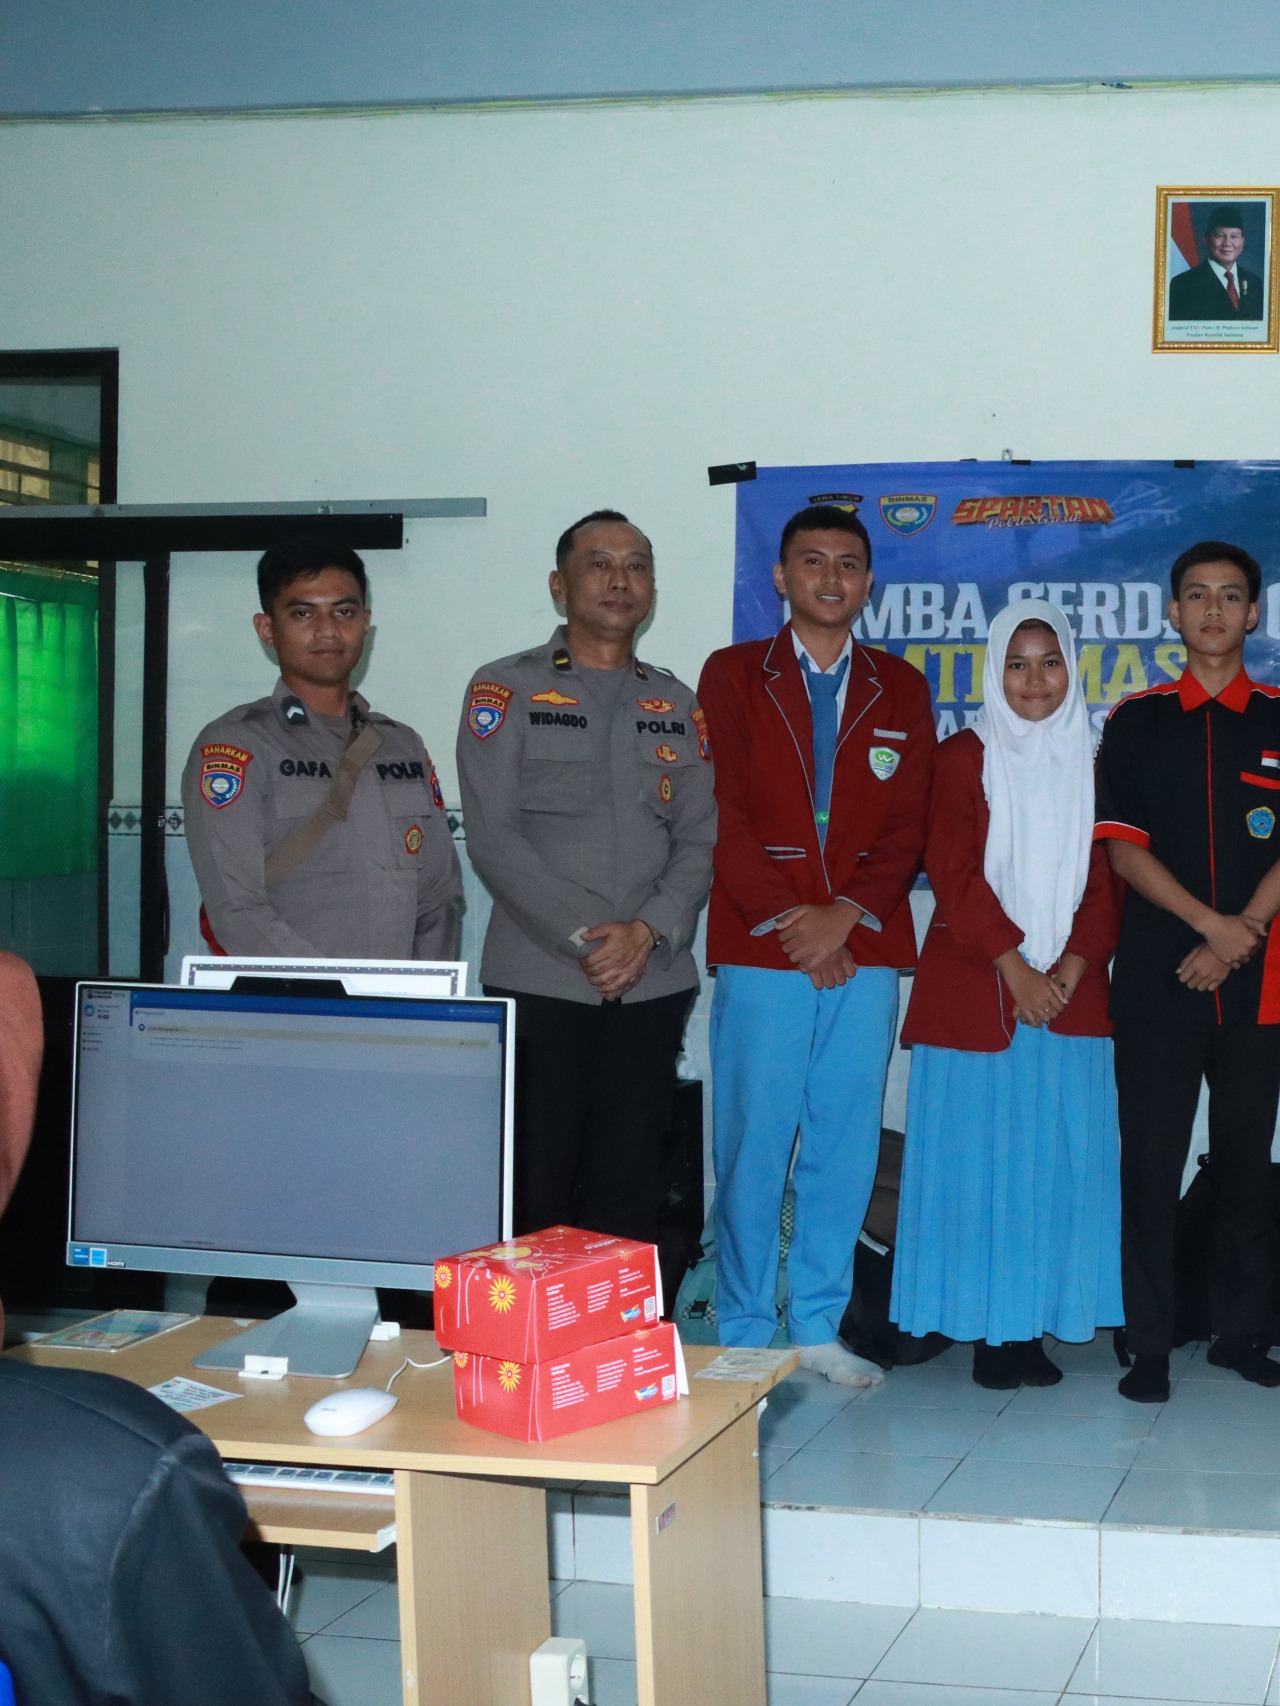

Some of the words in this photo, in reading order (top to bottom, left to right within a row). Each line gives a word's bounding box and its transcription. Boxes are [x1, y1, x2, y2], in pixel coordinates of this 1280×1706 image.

[951, 495, 1115, 524] SPARTAN
[784, 583, 989, 639] MBA
[529, 711, 588, 729] WIDAGDO
[636, 720, 686, 736] POLRI
[204, 746, 249, 762] BAHARKAM
[206, 763, 241, 773] BINMAS
[279, 758, 332, 779] GAFA
[375, 761, 425, 780] POLRI
